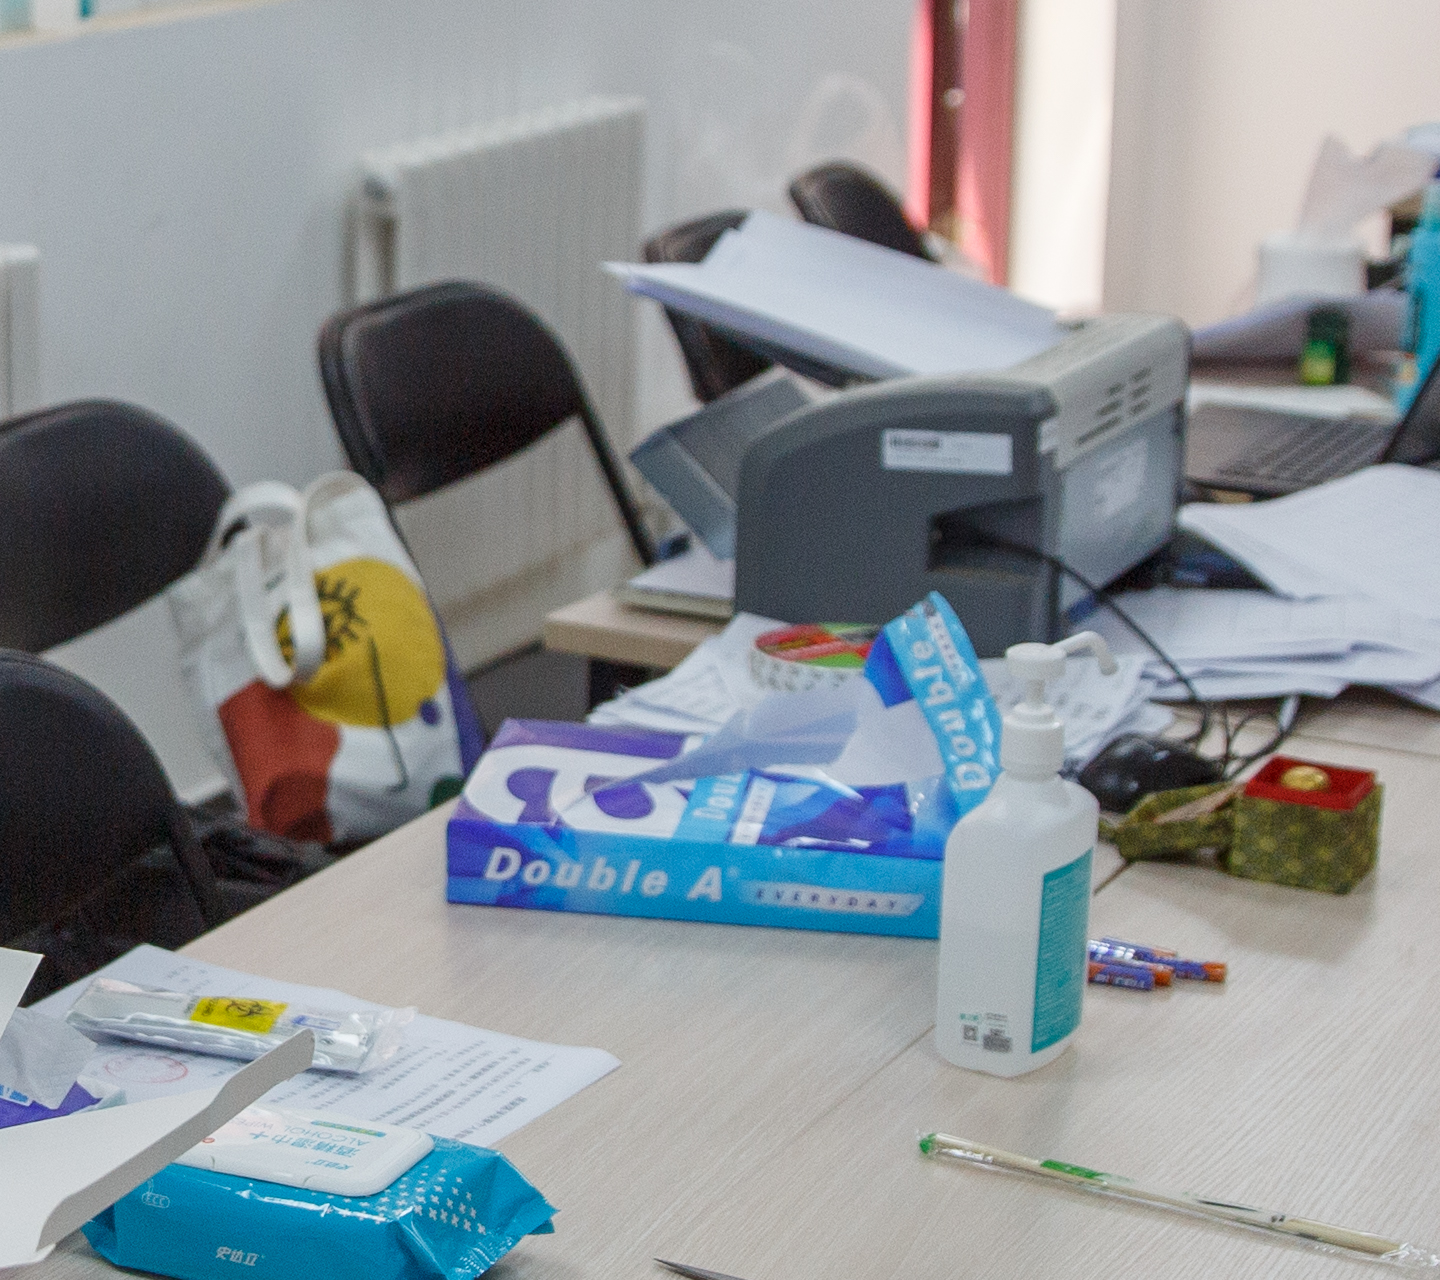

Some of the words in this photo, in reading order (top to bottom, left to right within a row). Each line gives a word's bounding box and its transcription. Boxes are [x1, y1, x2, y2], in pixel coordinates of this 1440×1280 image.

[908, 639, 991, 791] Double
[483, 846, 670, 898] Double
[687, 865, 725, 903] A
[754, 888, 901, 911] EVERYDAY
[284, 1125, 369, 1147] ALCOHOL
